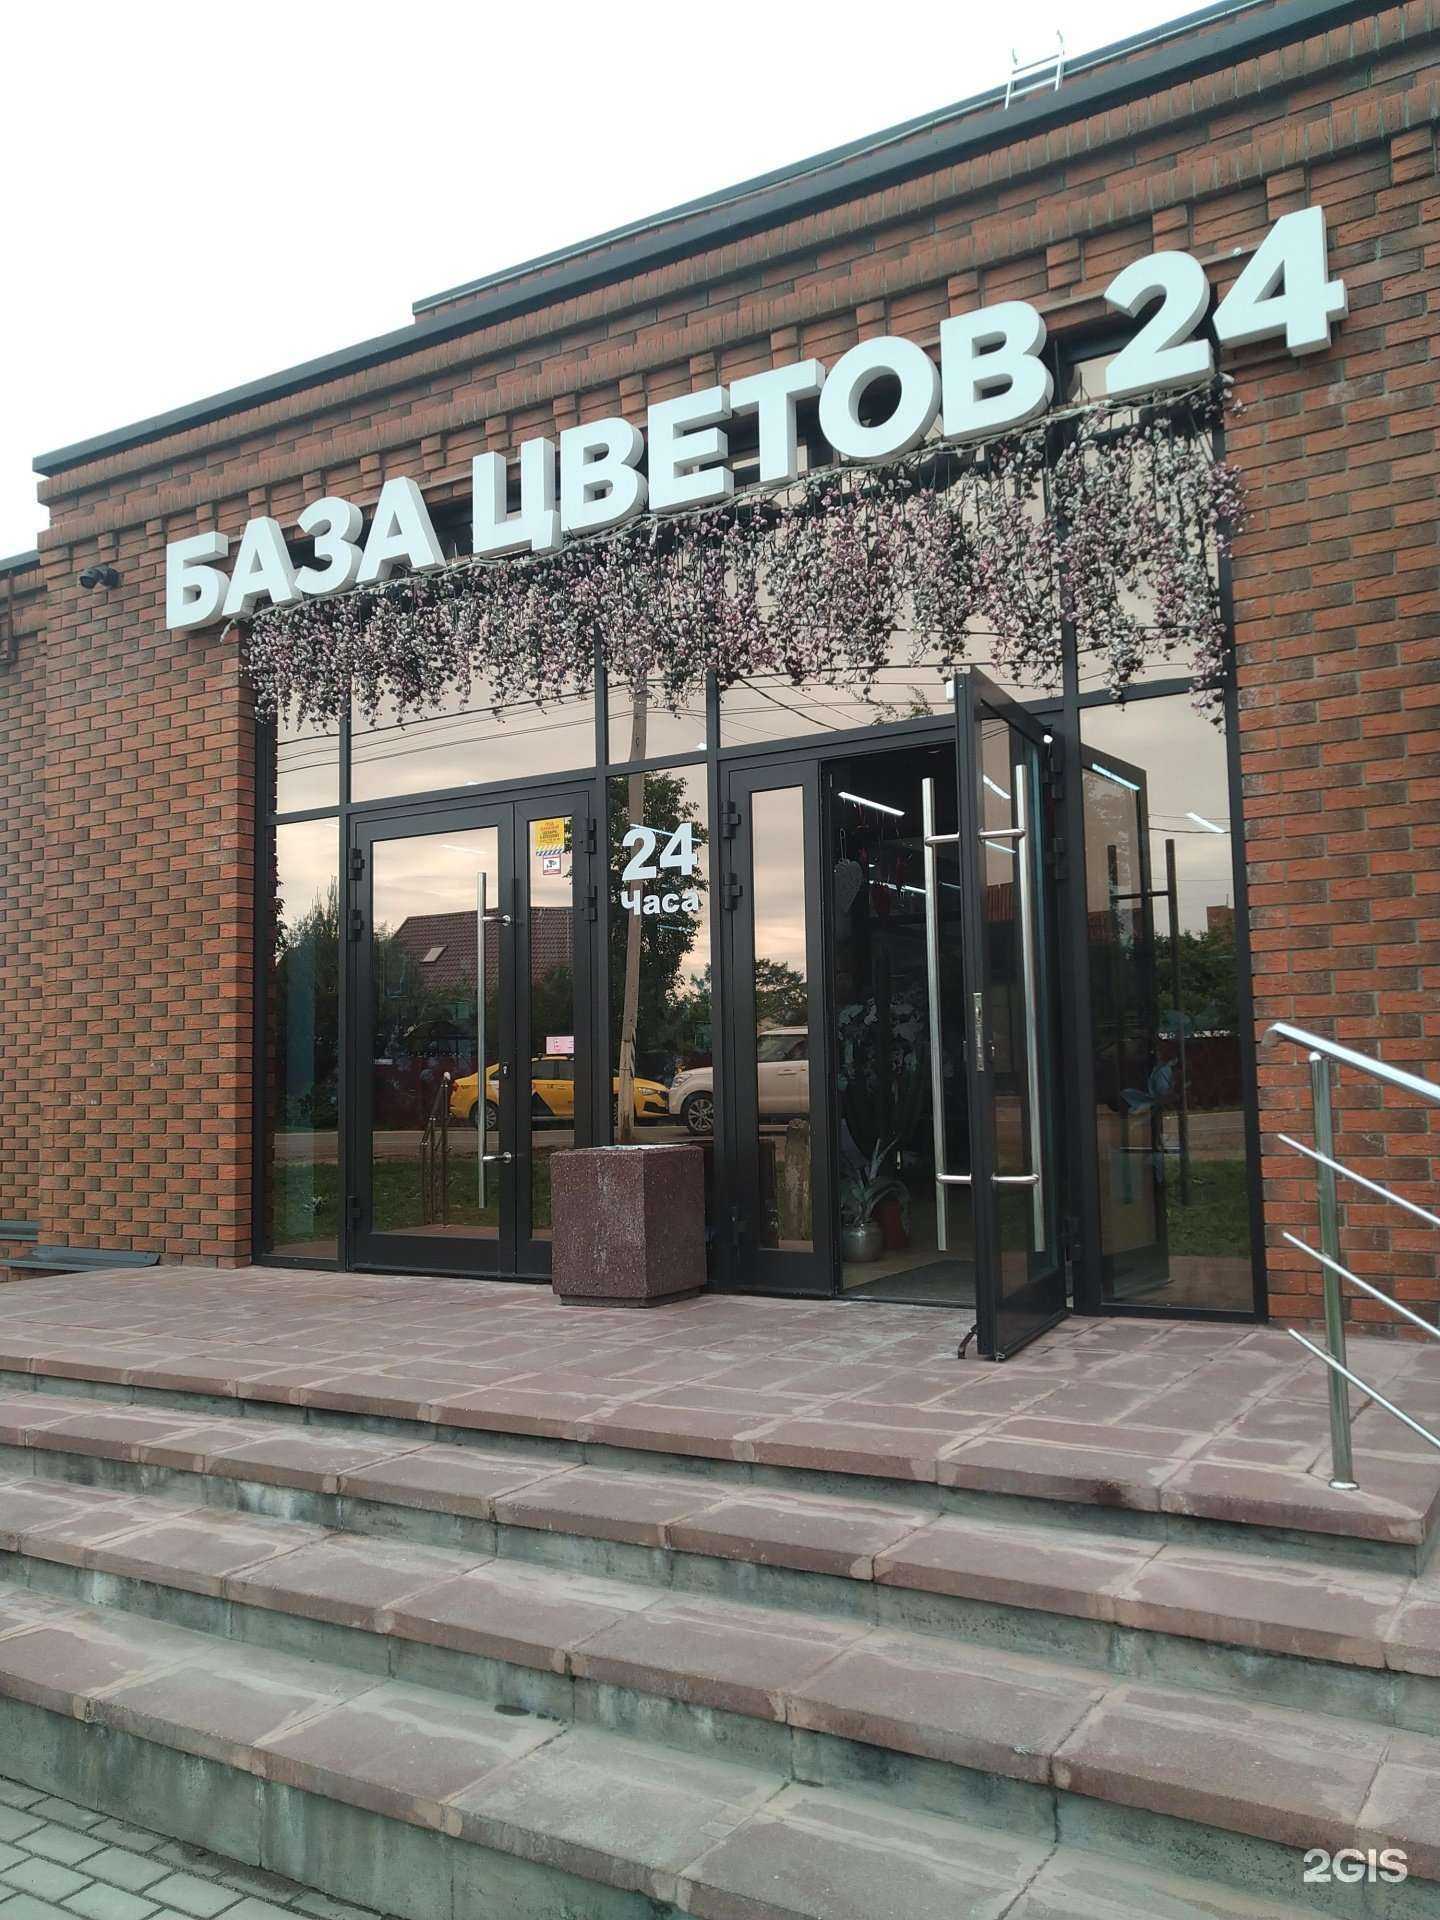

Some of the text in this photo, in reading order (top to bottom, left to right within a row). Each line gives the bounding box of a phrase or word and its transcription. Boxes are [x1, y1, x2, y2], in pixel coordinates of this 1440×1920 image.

[165, 204, 1349, 631] БАЗА ЦВЕТОВ 24
[621, 822, 698, 881] 24
